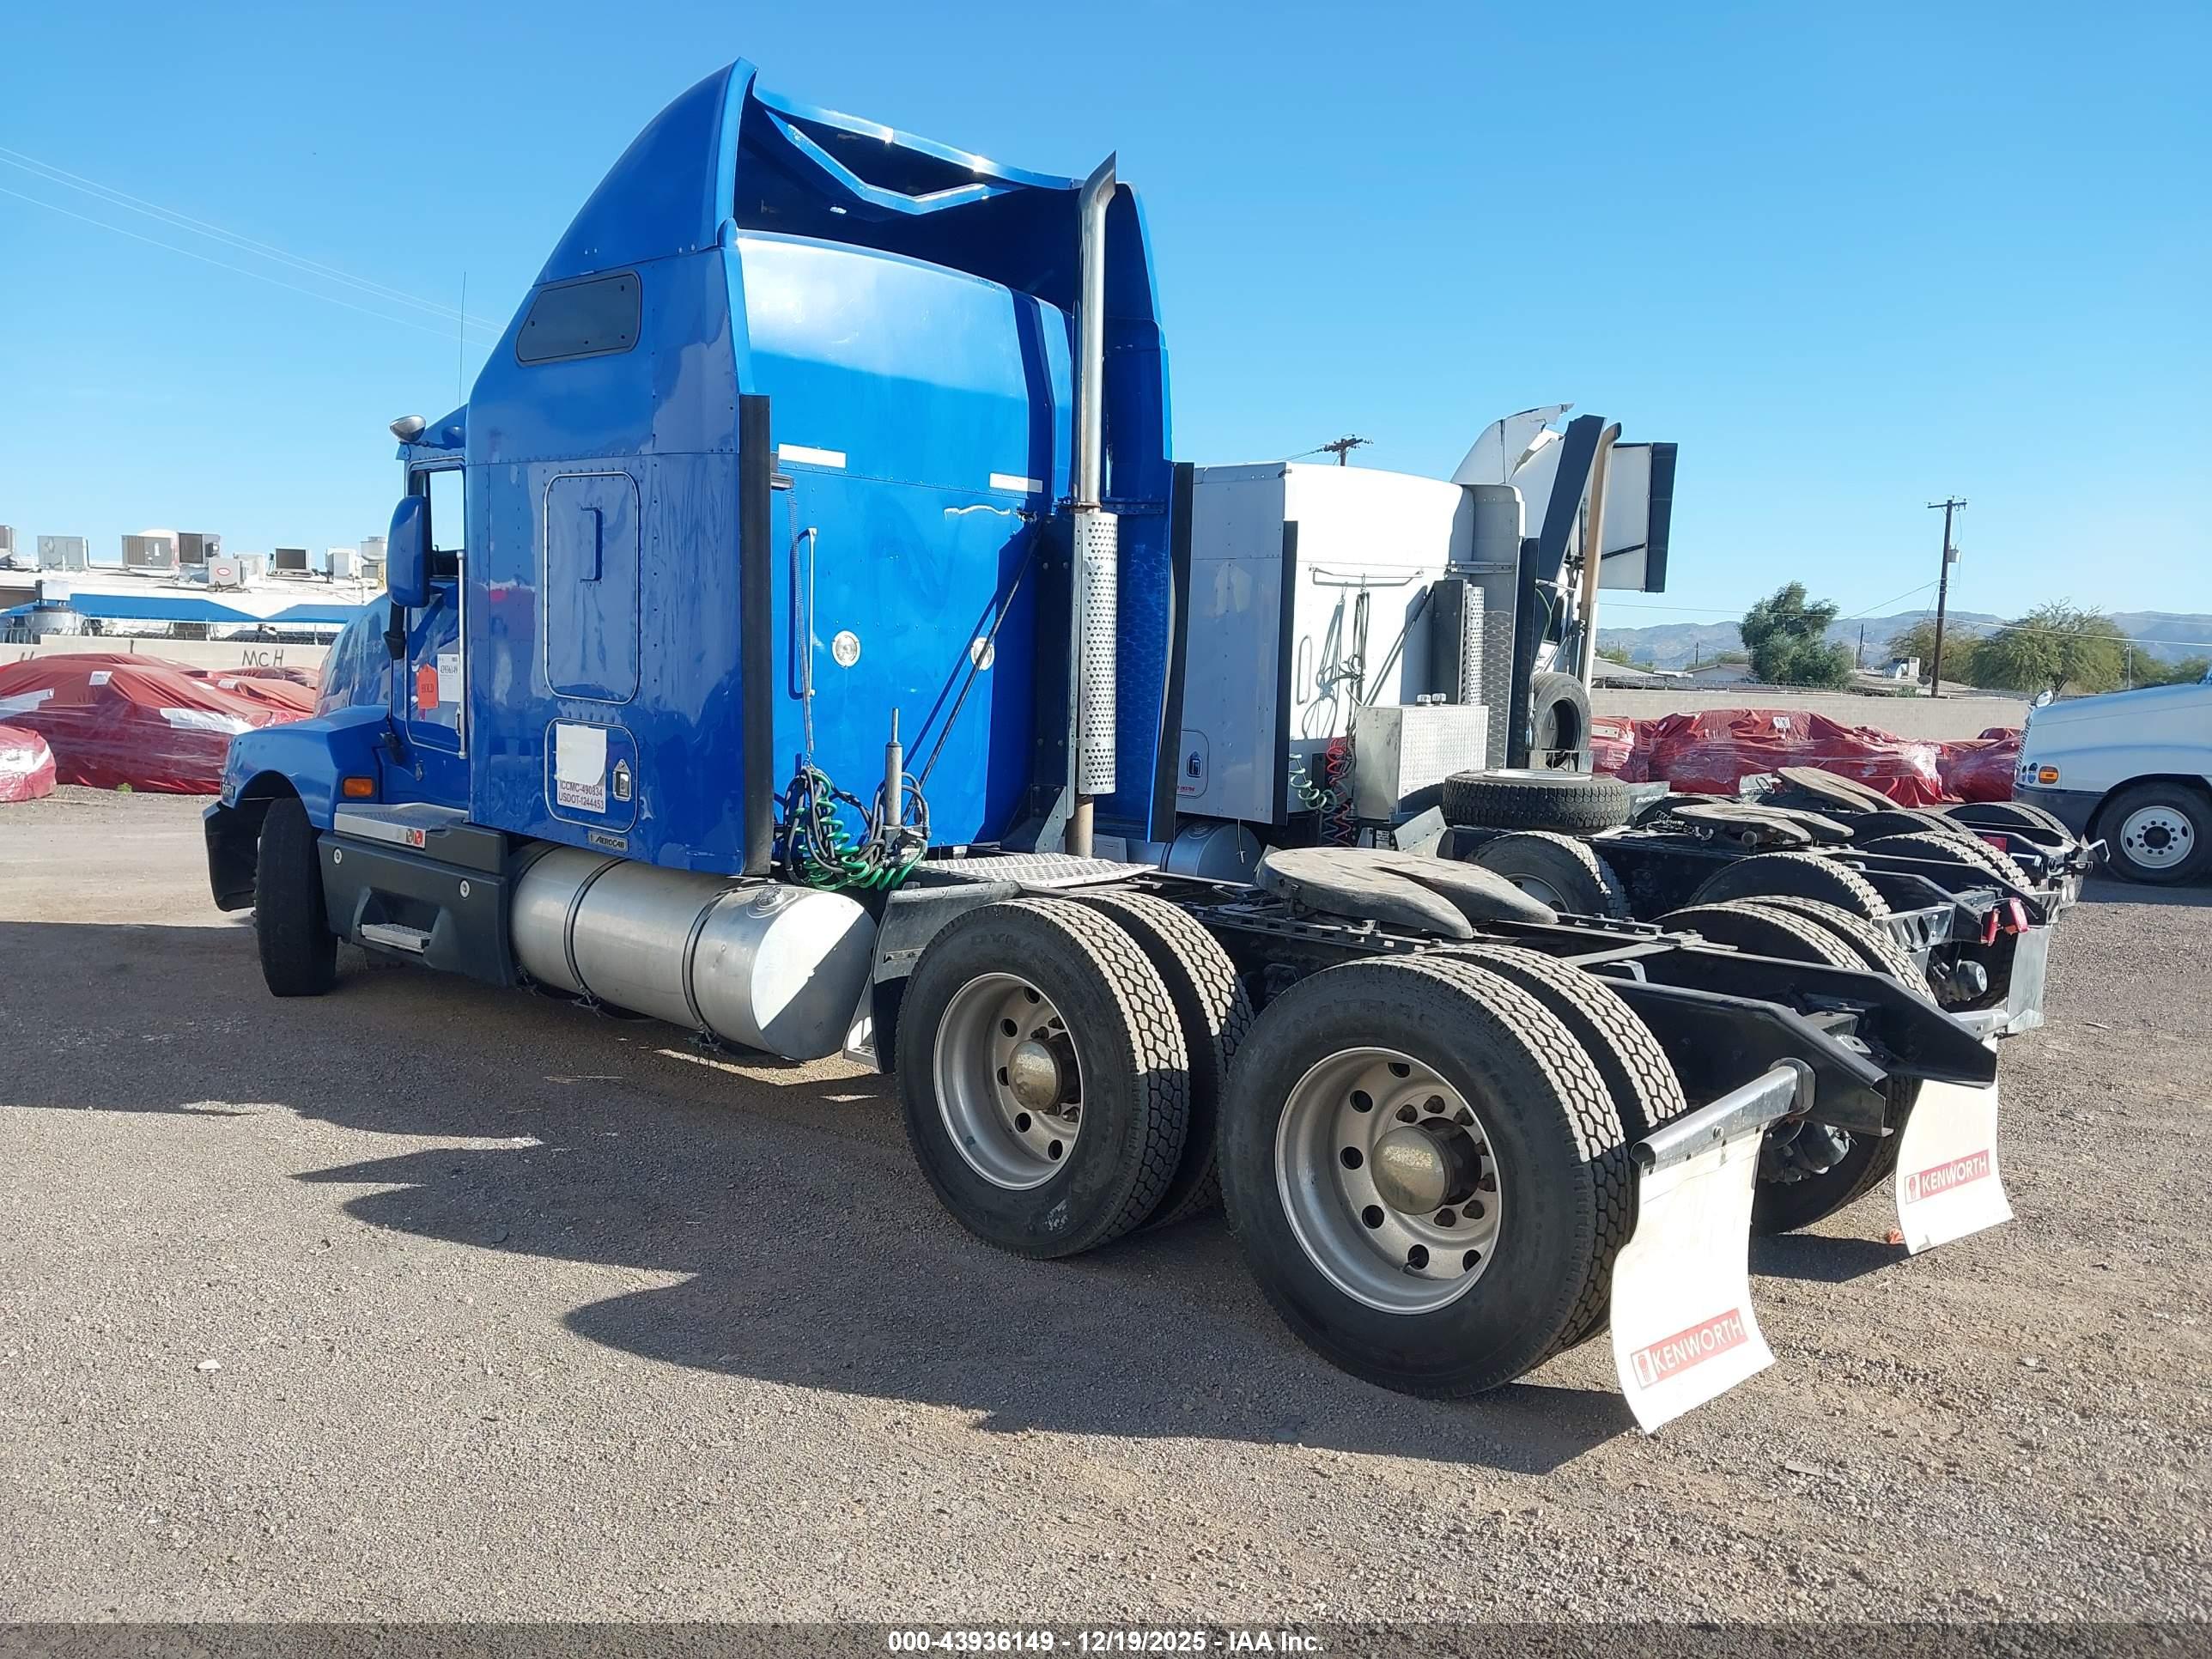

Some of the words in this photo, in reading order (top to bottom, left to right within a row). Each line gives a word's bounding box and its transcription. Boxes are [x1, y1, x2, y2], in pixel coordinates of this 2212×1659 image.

[558, 792, 605, 810] USDOT-1244453
[1922, 1153, 1988, 1194] KENWORTH
[1652, 1315, 1744, 1374] KENWORTH
